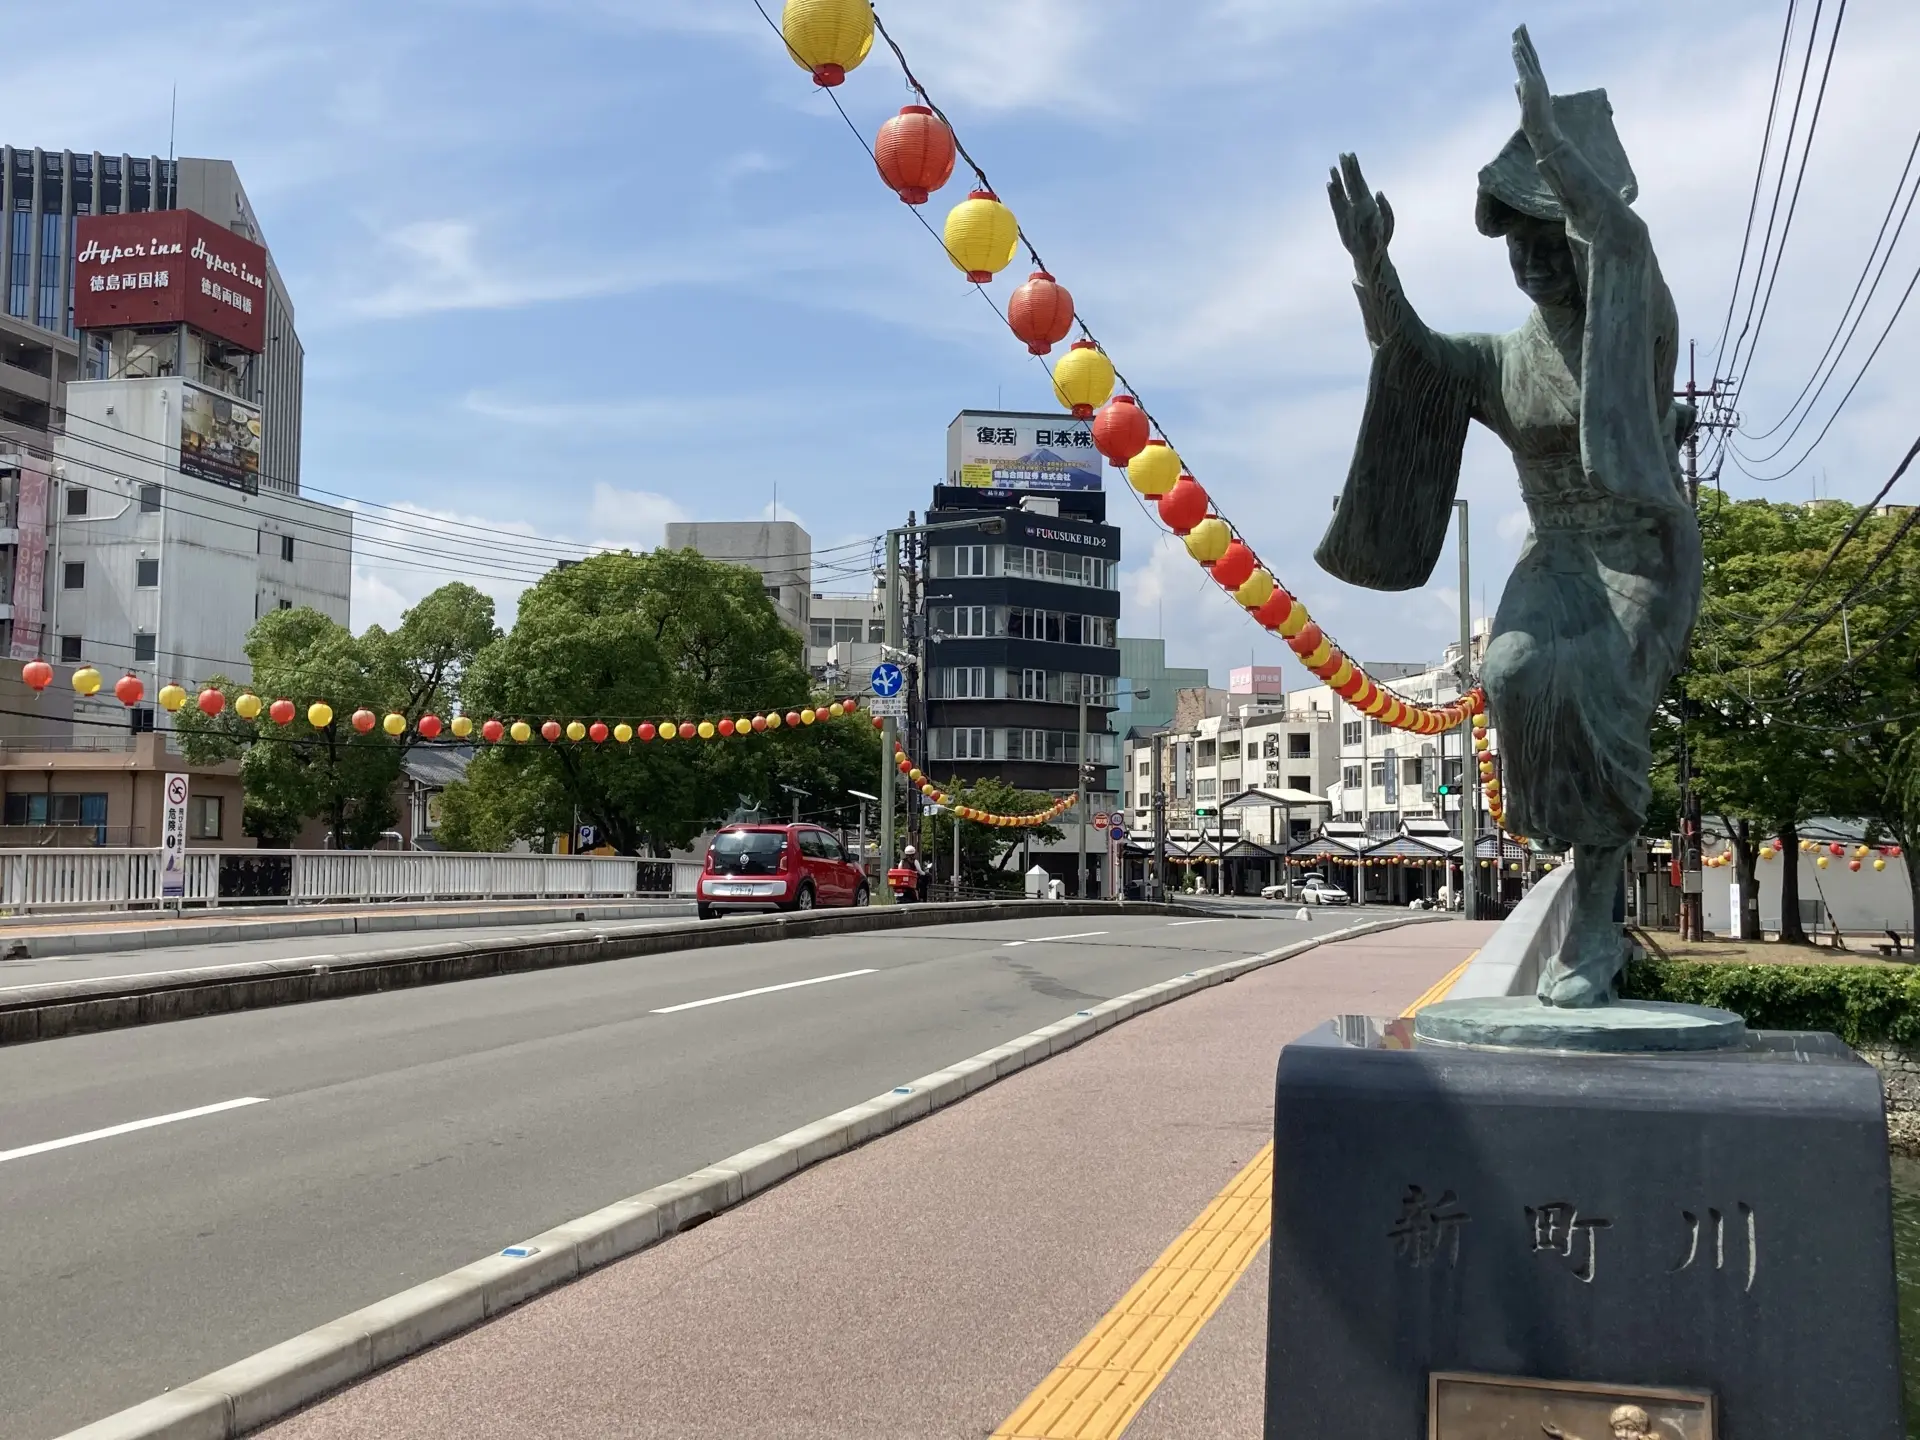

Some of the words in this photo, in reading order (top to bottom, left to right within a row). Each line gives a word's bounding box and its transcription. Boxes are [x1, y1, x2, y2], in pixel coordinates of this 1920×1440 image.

[78, 239, 146, 265] Hyper
[149, 237, 183, 256] inn
[190, 237, 238, 277] Hyper
[240, 262, 263, 289] inn
[90, 270, 169, 293] 徳島両国橋
[201, 276, 252, 315] 徳島両国橋
[976, 426, 1016, 446] 復活
[1036, 430, 1093, 448] 日本株
[1036, 528, 1082, 544] FUKUSUKE
[168, 808, 176, 831] 危険
[1386, 1183, 1757, 1293] 新町川
